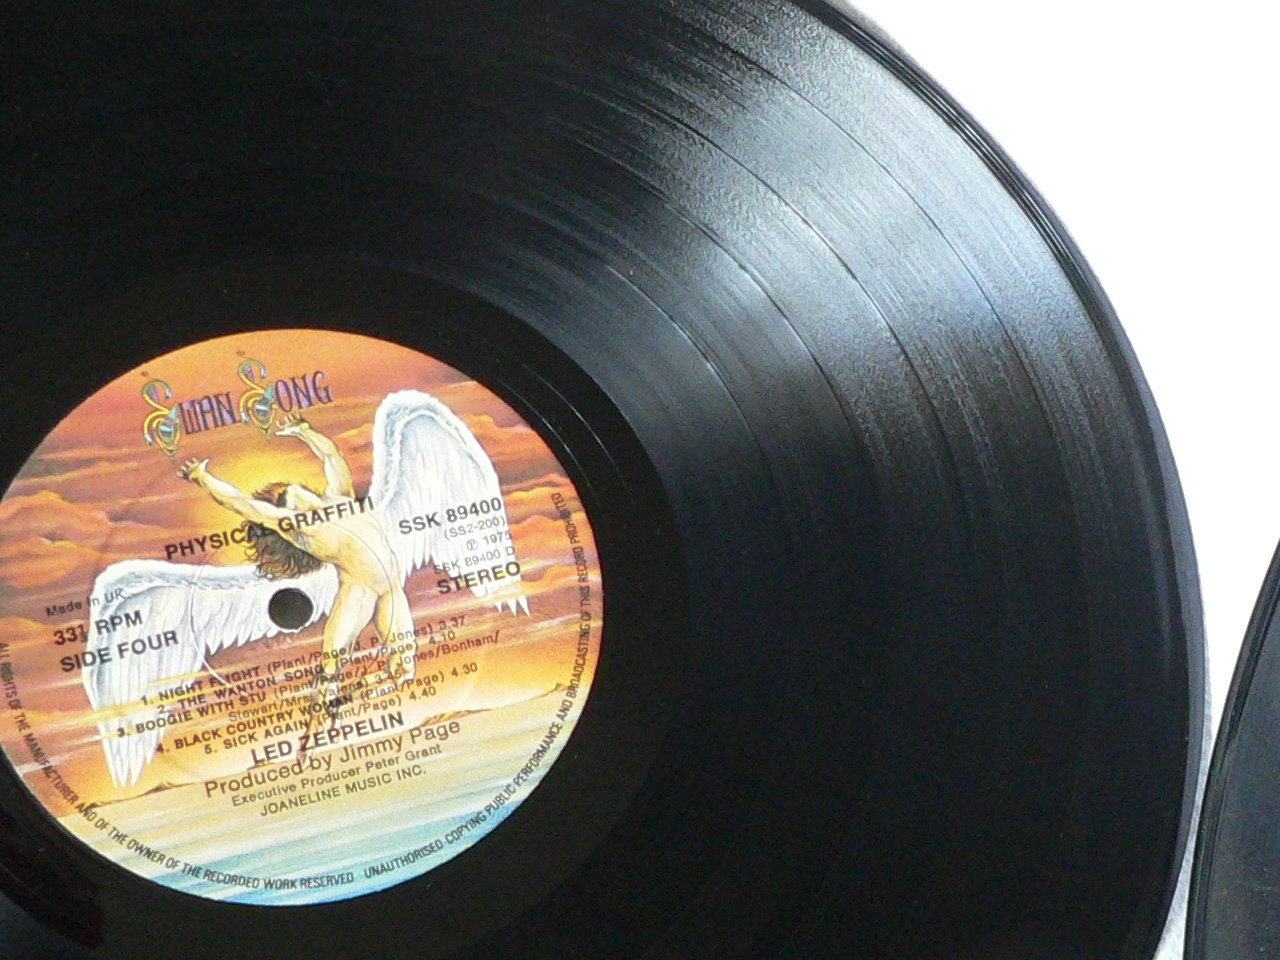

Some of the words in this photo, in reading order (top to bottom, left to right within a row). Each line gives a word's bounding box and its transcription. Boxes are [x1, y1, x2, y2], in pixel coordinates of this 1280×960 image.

[165, 520, 273, 560] PHYSICAL
[277, 495, 373, 532] GRAFFITI
[398, 511, 440, 535] SSK
[445, 496, 501, 523] 89400
[444, 515, 506, 540] (SS2-200)
[484, 529, 512, 544] 1975
[433, 559, 460, 574] SSK
[464, 549, 500, 566] 89400
[505, 545, 515, 555] D
[437, 560, 521, 594] STEREO
[46, 598, 82, 616] Made
[87, 594, 99, 606] in
[103, 588, 125, 603] UK
[95, 610, 142, 635] RPM
[60, 646, 112, 672] SIDE
[116, 630, 177, 658] FOUR
[156, 703, 169, 714] 2.
[178, 693, 206, 708] THE
[215, 676, 276, 699] WANTON
[284, 664, 324, 682] SONG
[334, 639, 418, 669] (Plant/Page)
[428, 630, 456, 645] 4.10
[159, 681, 204, 701] NIGHT
[210, 666, 261, 687] FLIGHT
[388, 623, 432, 643] Jones)
[439, 615, 465, 630] 3.37
[116, 726, 129, 737] 3.
[135, 710, 192, 733] BOOGIE
[197, 699, 233, 716] WITH
[239, 691, 265, 705] STU
[155, 742, 169, 754] 4.
[174, 728, 221, 748] BLACK
[226, 709, 294, 735] COUNTRY
[300, 694, 353, 716] WOMAN
[359, 671, 444, 701] (Plant/Page)
[450, 662, 478, 677] 4.30
[204, 743, 216, 754] 5.
[223, 732, 257, 749] SICK
[263, 718, 309, 738] AGAIN
[409, 685, 436, 700] 4.40
[14, 711, 31, 734] THE
[24, 732, 79, 806] MANUFACTURER
[75, 800, 97, 822] AND
[94, 817, 111, 832] OF
[108, 826, 129, 846] THE
[126, 838, 166, 867] OWNER
[165, 856, 181, 869] OF
[181, 862, 205, 879] THE
[203, 869, 261, 889] RECORDED
[263, 876, 298, 891] WORK
[300, 871, 355, 890] RESERVED
[363, 838, 444, 879] UNAUTHORISED
[444, 811, 487, 845] COPYING
[484, 783, 517, 816] PUBLIC
[512, 721, 564, 788] PERFORMANCE
[555, 699, 575, 722] AND
[565, 622, 591, 700] BROADCASTING
[205, 759, 303, 797] Produced
[308, 751, 333, 774] by
[339, 733, 405, 766] Jimmy
[410, 718, 461, 747] Page
[251, 740, 293, 764] LED
[298, 711, 403, 751] ZEPPELIN
[231, 781, 296, 806] Executive
[301, 765, 361, 789] Producer
[365, 754, 400, 772] Peter
[404, 743, 441, 762] Grant
[259, 786, 340, 816] JOANELINE
[345, 773, 391, 793] MUSIC
[396, 763, 426, 781] INC.
